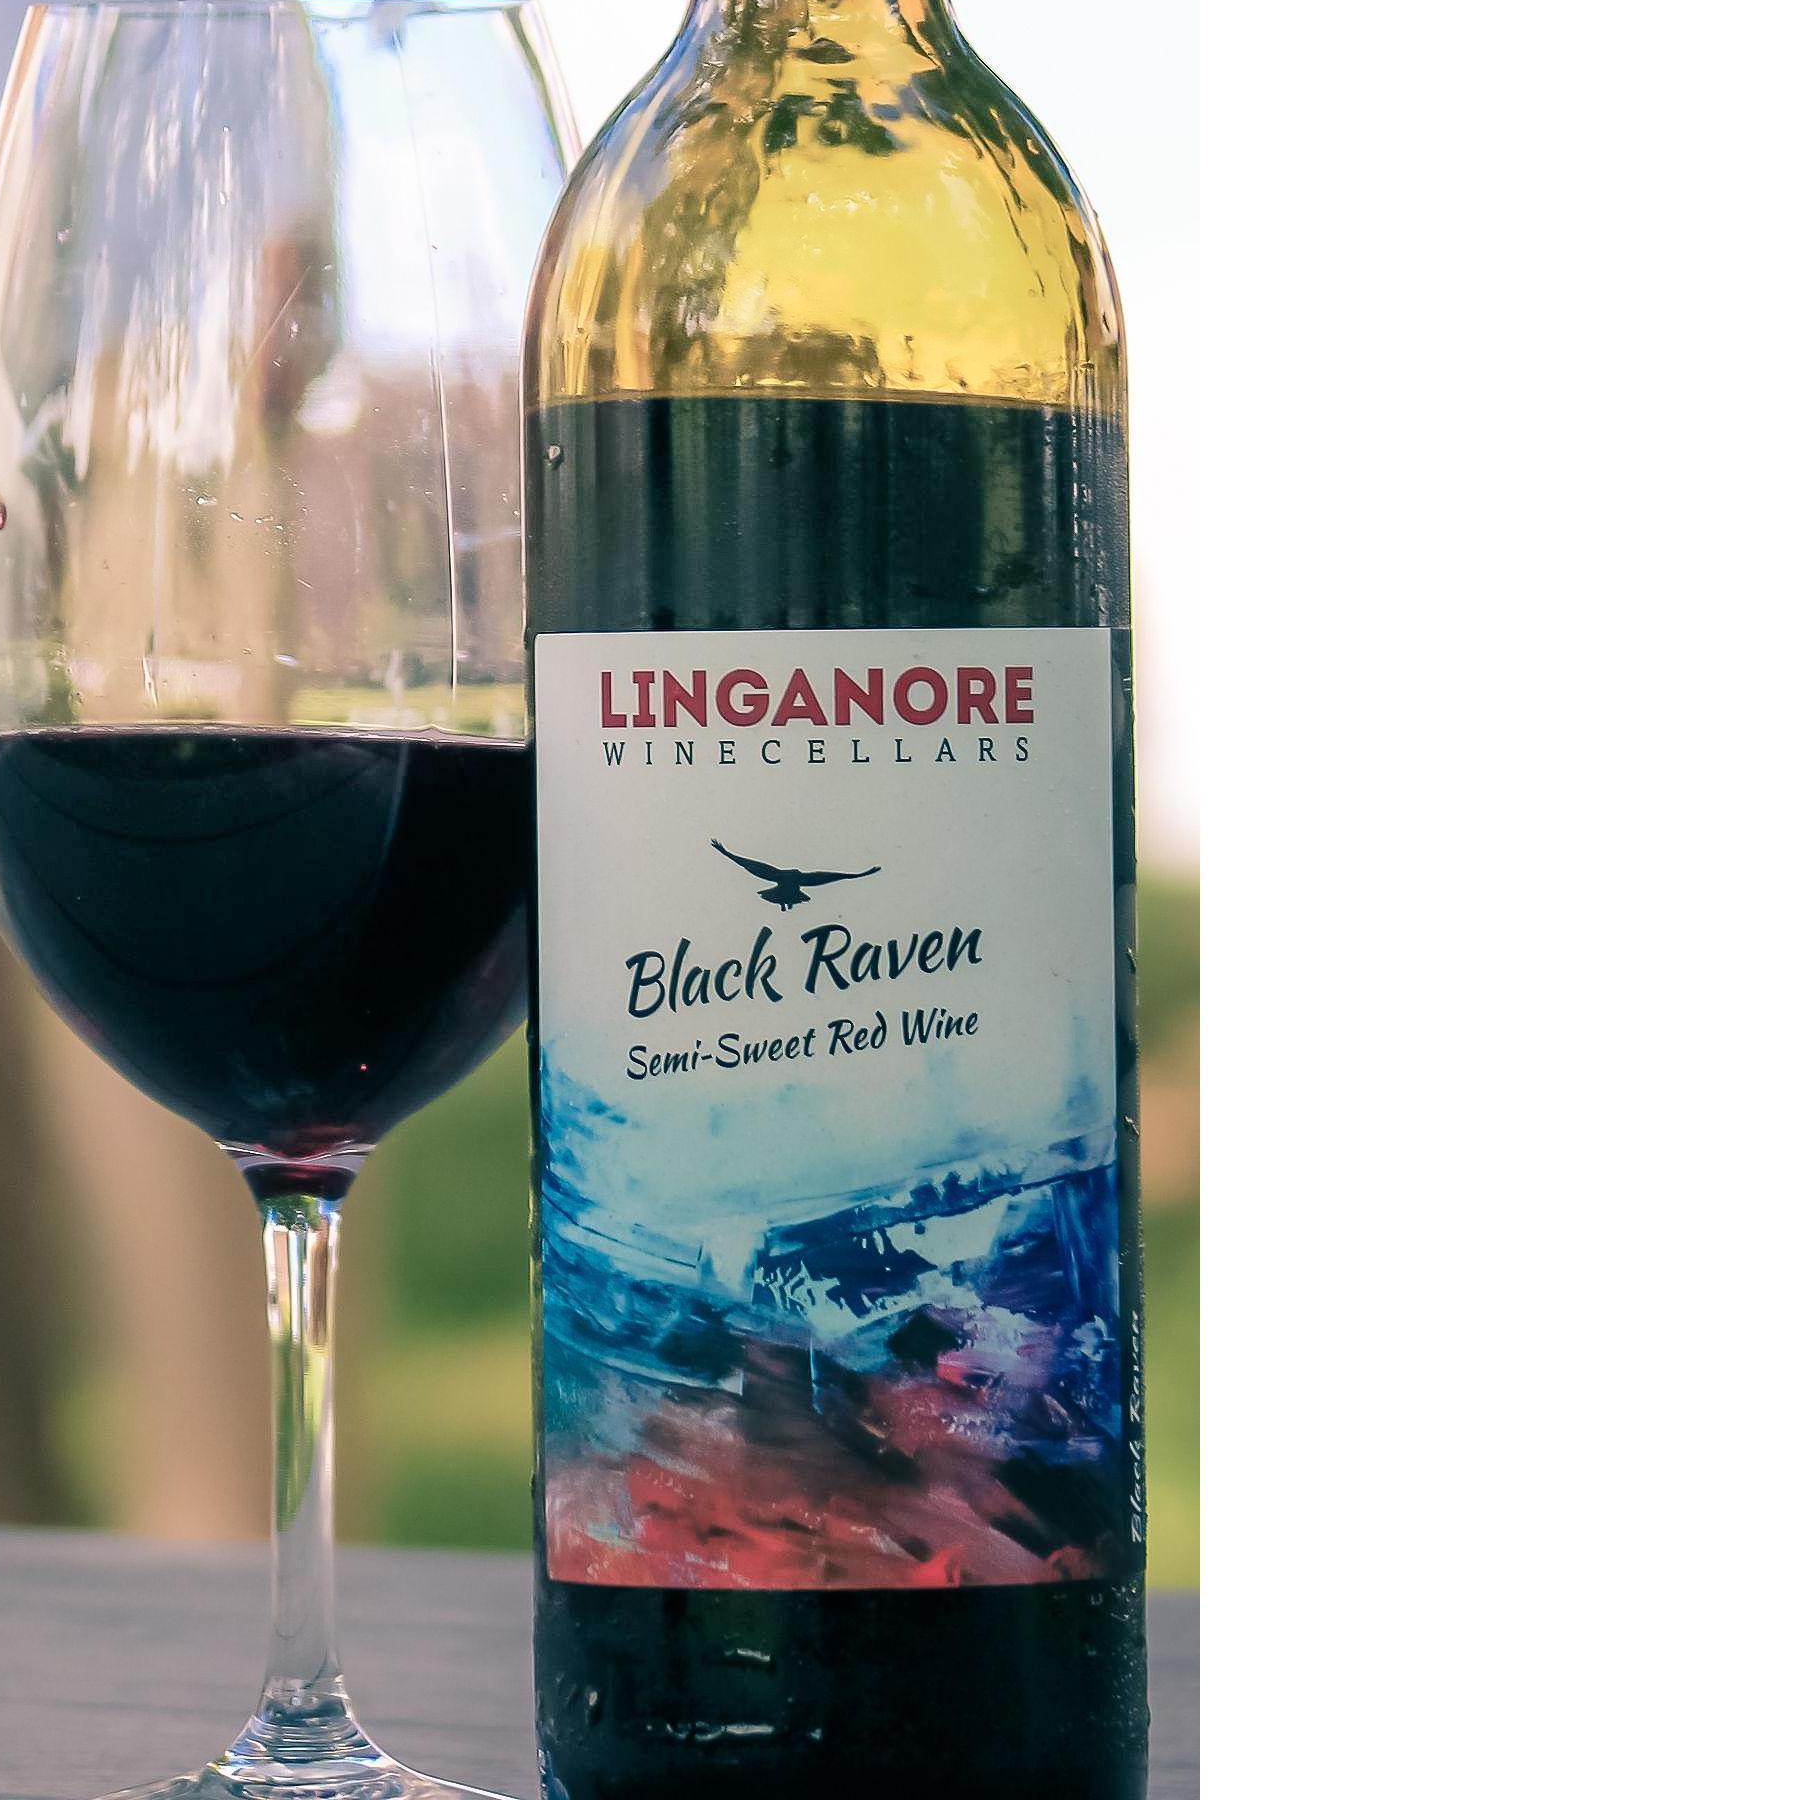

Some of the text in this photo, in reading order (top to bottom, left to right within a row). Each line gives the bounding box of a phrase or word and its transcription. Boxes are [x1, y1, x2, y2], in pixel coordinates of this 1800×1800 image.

[601, 666, 1035, 728] LINGANORE
[603, 736, 1030, 766] WINECELLARS
[625, 923, 983, 1019] Black Raven
[626, 1008, 979, 1080] Semi-Sweet Red Wine
